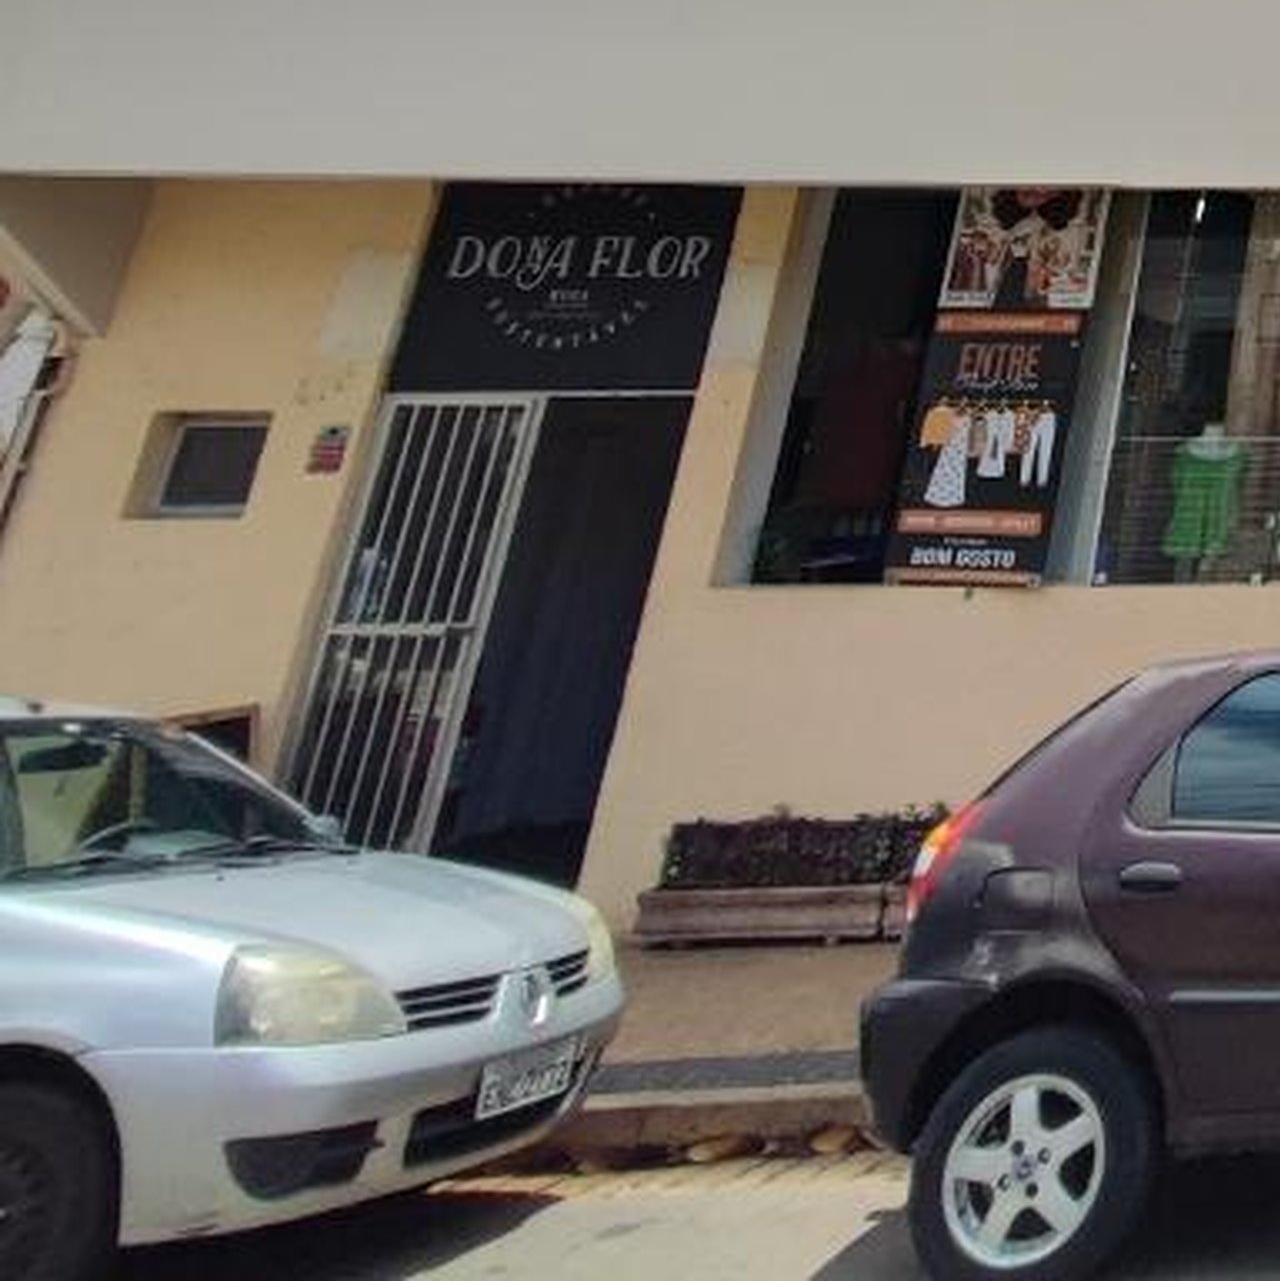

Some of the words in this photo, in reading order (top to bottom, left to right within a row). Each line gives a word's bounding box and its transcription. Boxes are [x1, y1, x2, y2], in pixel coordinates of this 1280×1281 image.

[447, 235, 577, 290] DONA
[588, 235, 711, 279] FLOR
[959, 343, 1042, 381] ENTRE
